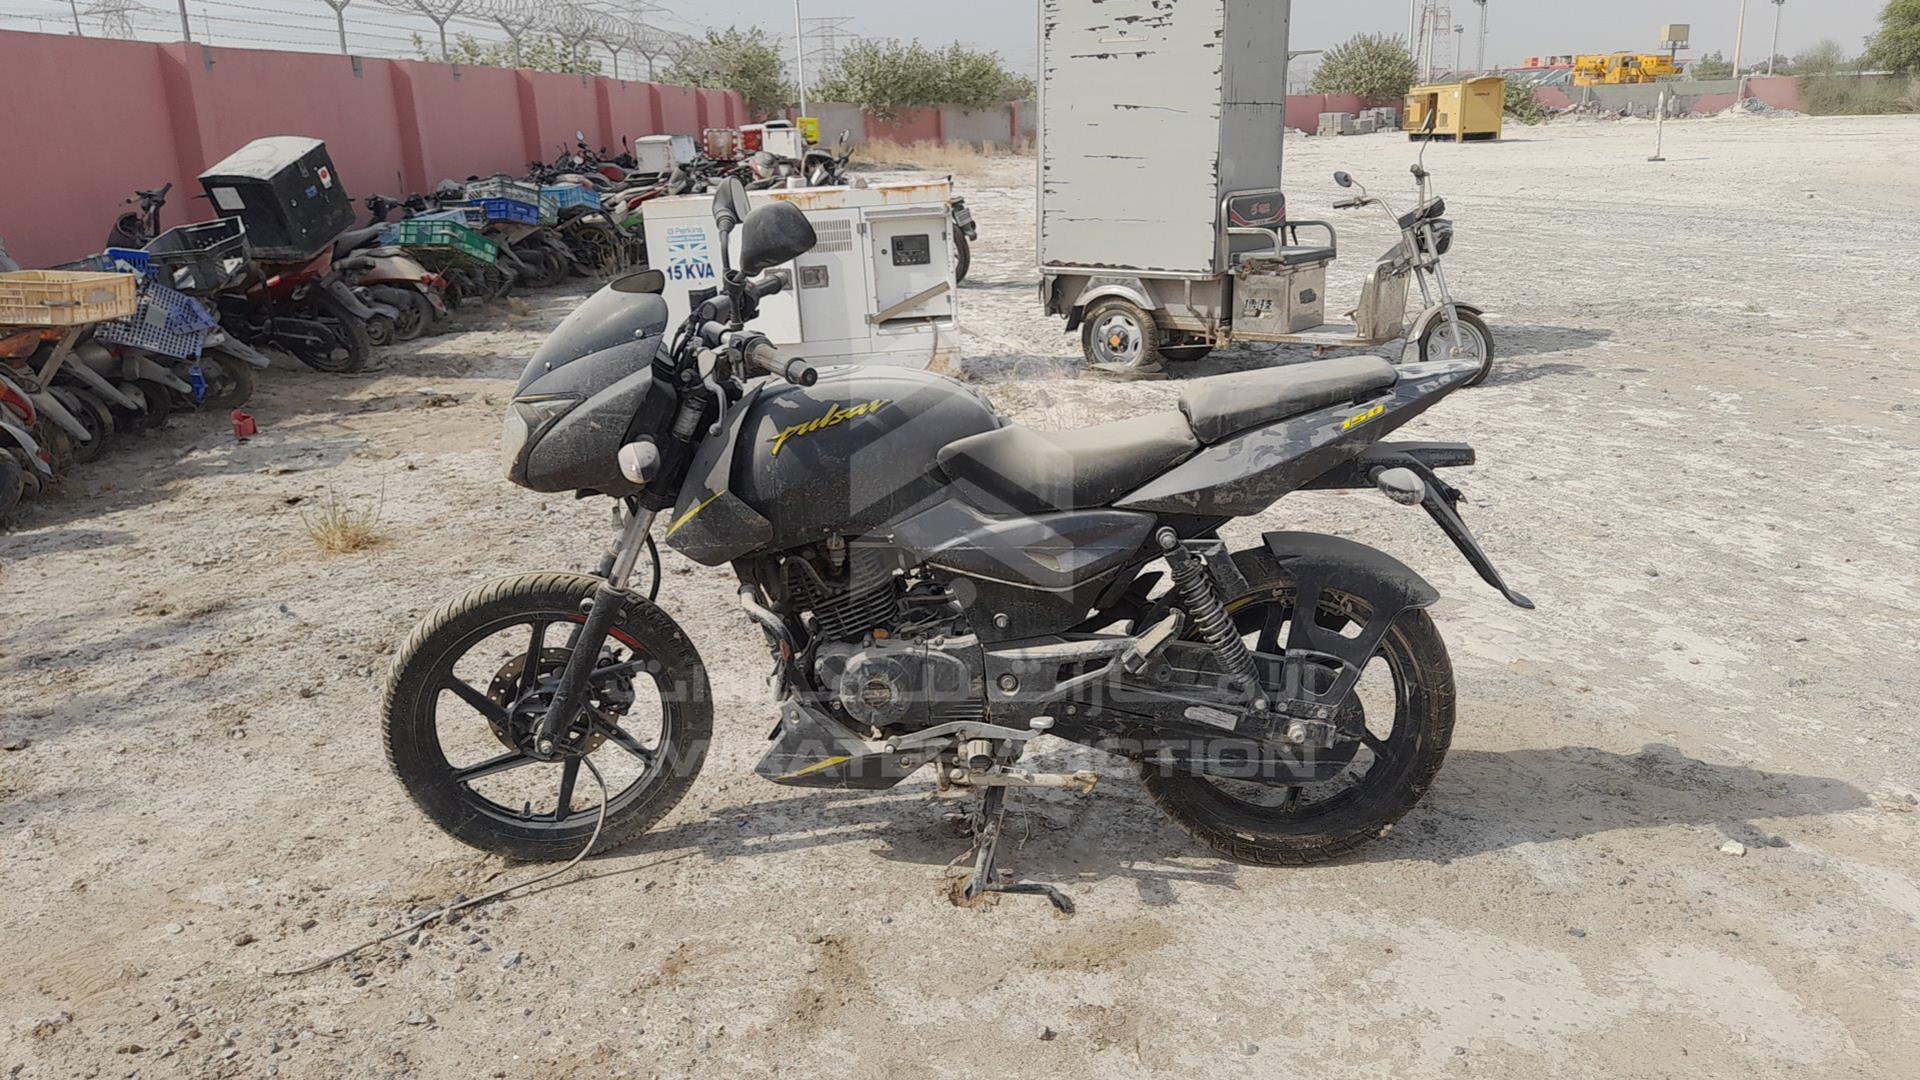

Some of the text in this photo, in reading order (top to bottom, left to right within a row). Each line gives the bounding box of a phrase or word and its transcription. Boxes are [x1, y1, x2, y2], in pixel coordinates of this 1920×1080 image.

[667, 263, 715, 280] 15 KVA
[1342, 404, 1386, 431] 150
